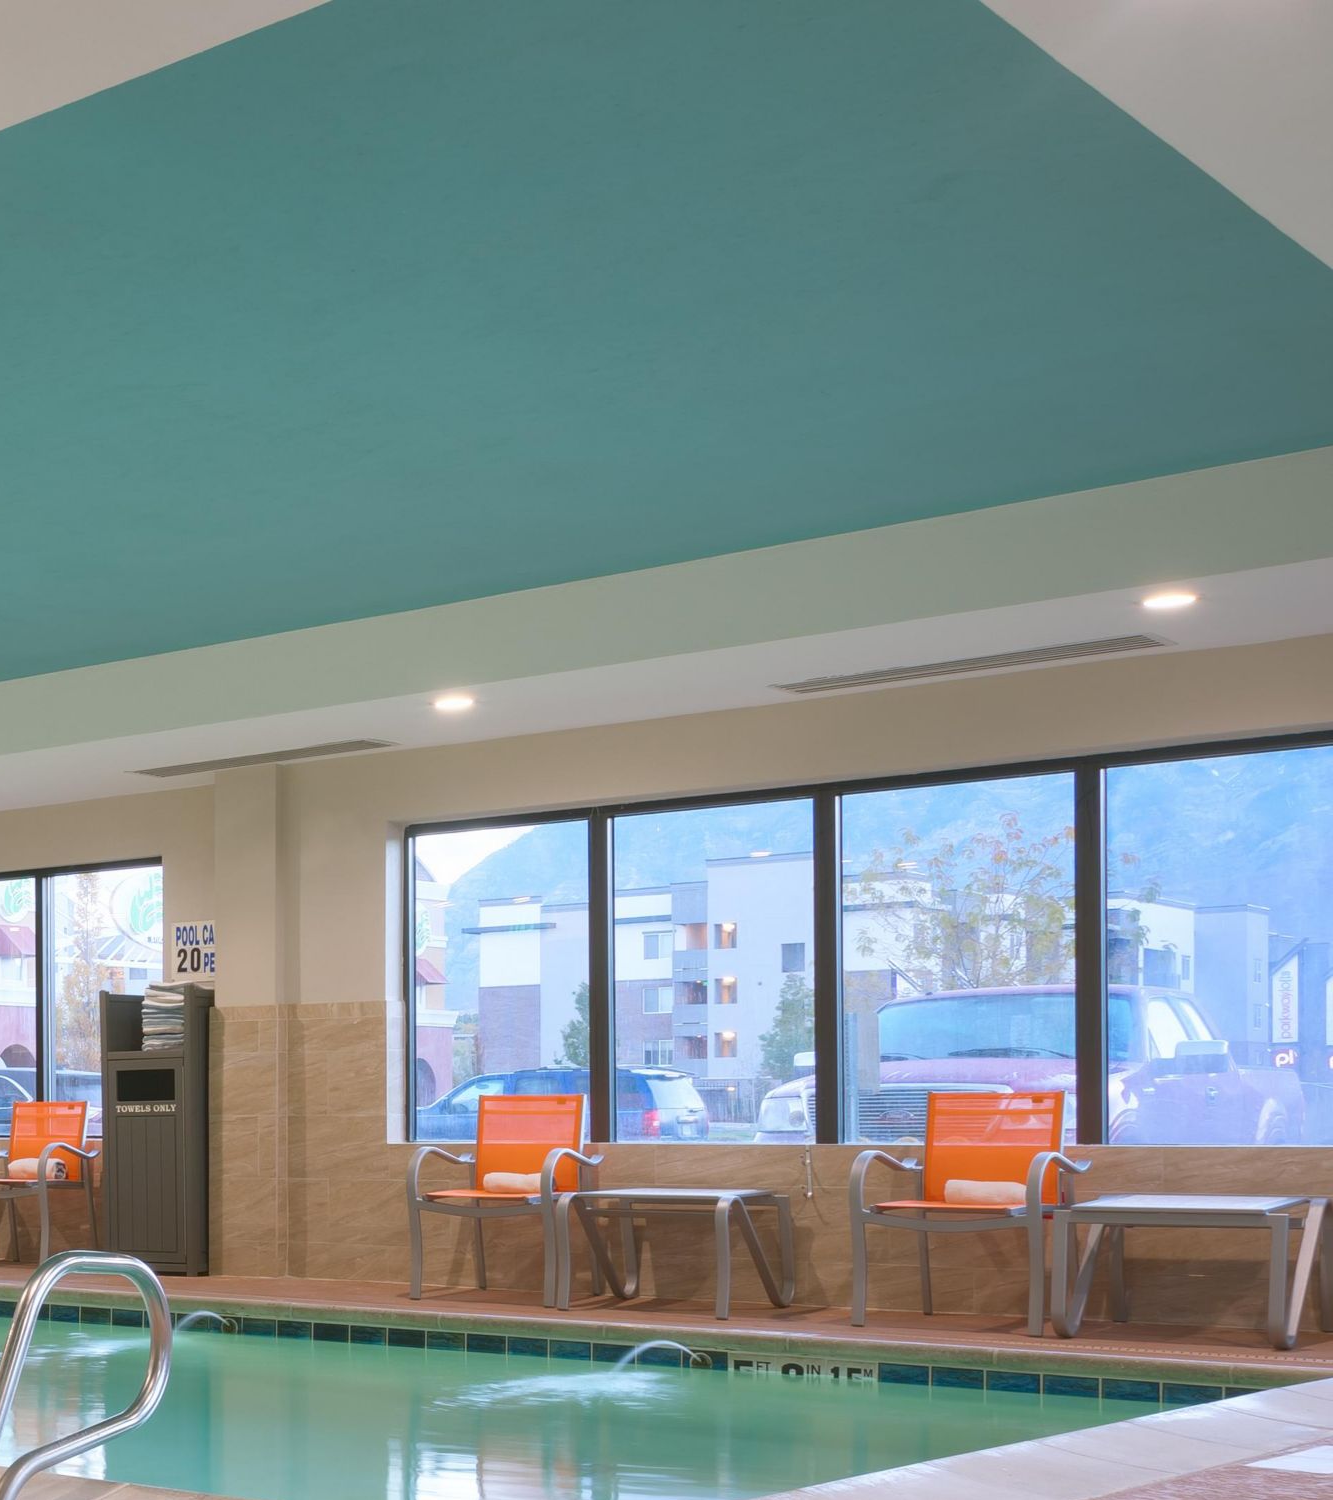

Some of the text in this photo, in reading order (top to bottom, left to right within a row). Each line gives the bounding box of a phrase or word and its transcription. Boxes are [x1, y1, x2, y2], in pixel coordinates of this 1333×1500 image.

[175, 925, 200, 947] POOL
[177, 947, 201, 973] 20
[115, 1104, 177, 1113] TOWELS ONLY
